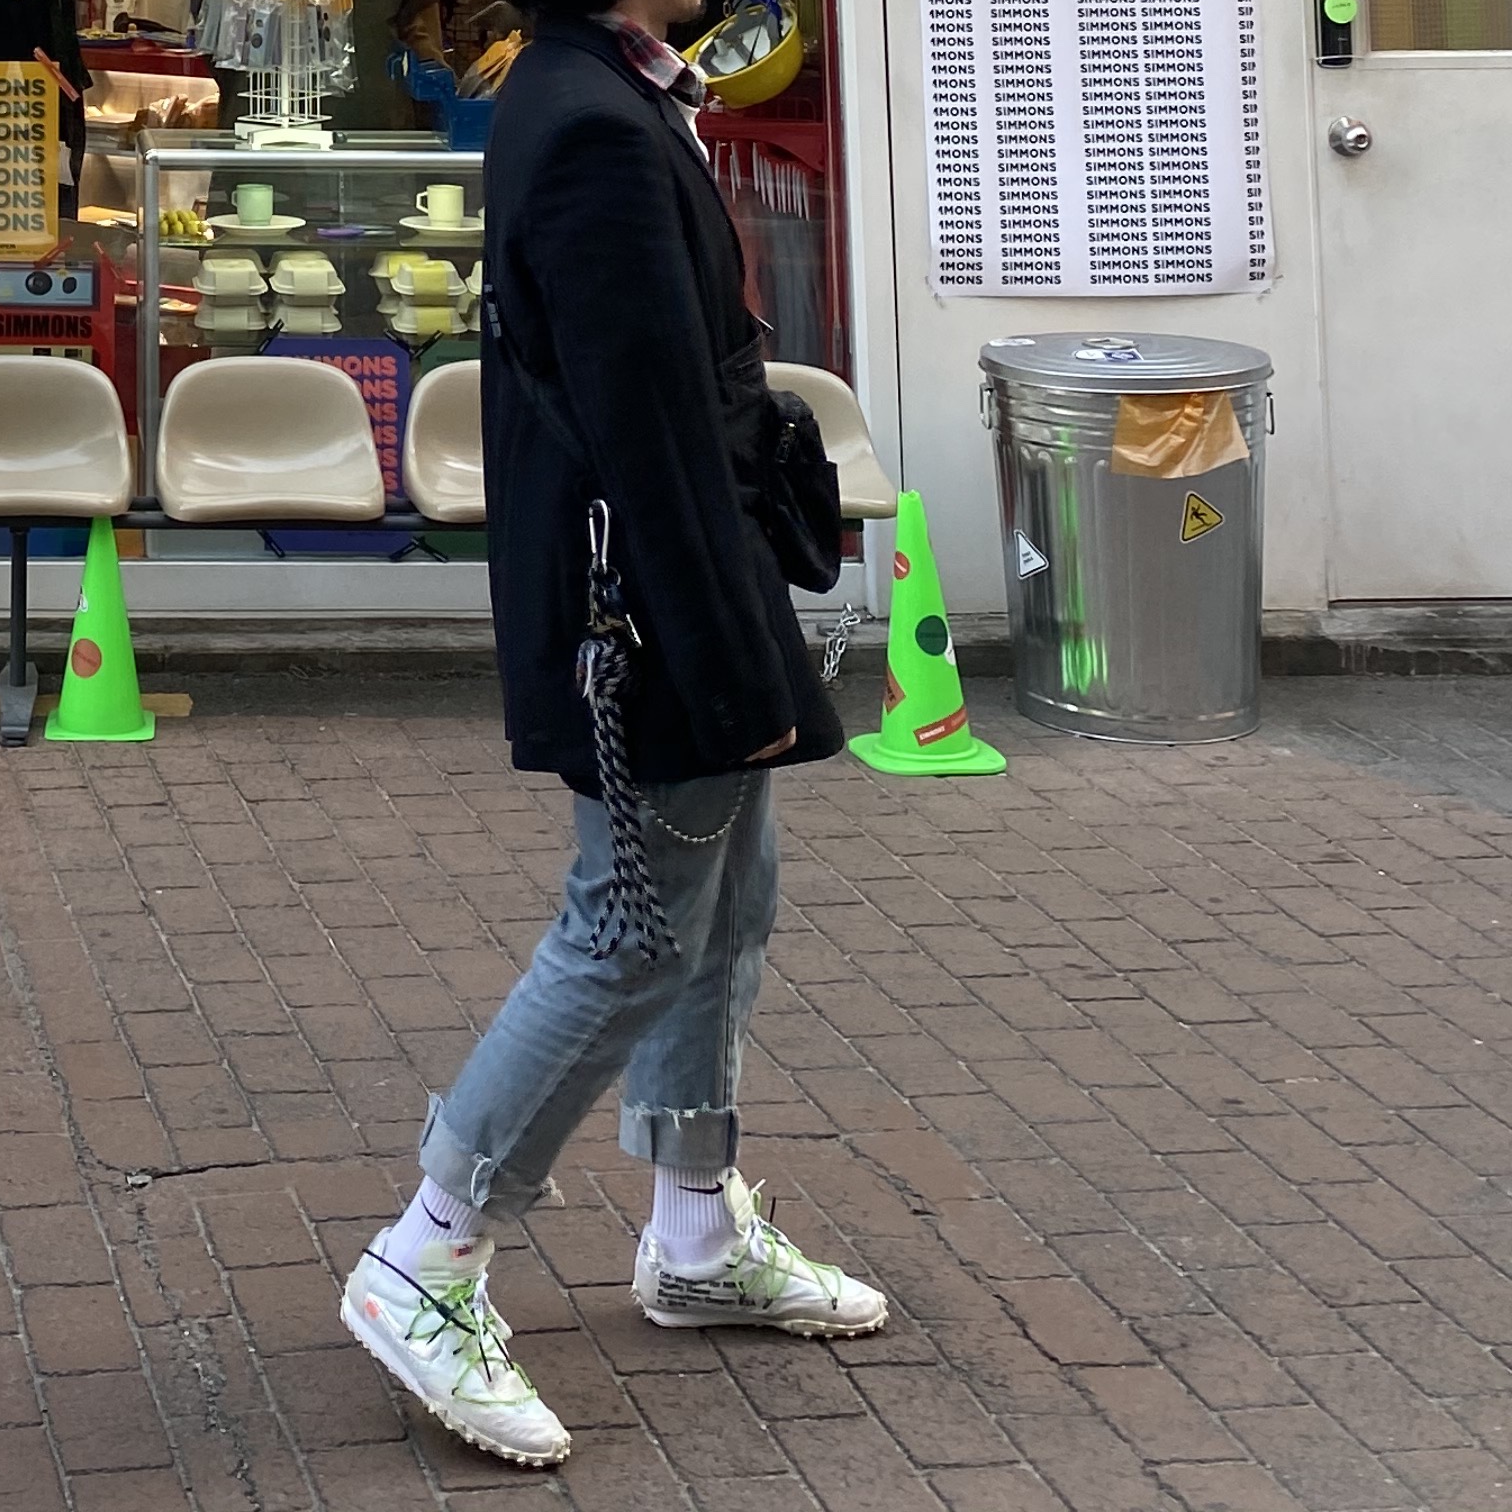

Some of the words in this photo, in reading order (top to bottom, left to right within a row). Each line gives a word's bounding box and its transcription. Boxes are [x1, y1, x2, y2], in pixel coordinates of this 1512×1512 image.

[991, 9, 1049, 18] SIMMONS
[1078, 8, 1136, 17] SIMMONS
[1141, 7, 1201, 17] SIMMONS
[991, 23, 1050, 32] SIMMONS
[1078, 22, 1137, 31] SIMMONS
[1142, 21, 1201, 31] SIMMONS
[992, 36, 1050, 46] SIMMONS
[1079, 35, 1138, 45] SIMMONS
[1143, 35, 1202, 45] SIMMONS
[993, 50, 1051, 60] SIMMONS
[1080, 50, 1138, 59] SIMMONS
[1143, 49, 1203, 58] SIMMONS
[993, 64, 1052, 74] SIMMONS
[1080, 63, 1139, 73] SIMMONS
[1144, 63, 1203, 72] SIMMONS
[995, 92, 1053, 102] SIMMONS
[1082, 91, 1141, 101] SIMMONS
[1145, 91, 1205, 101] SIMMONS
[995, 106, 1054, 116] SIMMONS
[1083, 106, 1141, 115] SIMMONS
[1146, 105, 1206, 114] SIMMONS
[996, 120, 1055, 130] SIMMONS
[1083, 119, 1142, 129] SIMMONS
[1147, 119, 1206, 128] SIMMONS
[997, 134, 1055, 144] SIMMONS
[1084, 133, 1143, 143] SIMMONS
[1148, 133, 1207, 142] SIMMONS
[997, 149, 1056, 158] SIMMONS
[1085, 147, 1143, 157] SIMMONS
[1149, 147, 1208, 157] SIMMONS
[999, 177, 1057, 186] SIMMONS
[1086, 175, 1145, 185] SIMMONS
[1150, 175, 1209, 184] SIMMONS
[999, 191, 1058, 201] SIMMONS
[1087, 190, 1146, 200] SIMMONS
[1151, 189, 1209, 199] SIMMONS
[1000, 205, 1058, 215] SIMMONS
[1087, 204, 1146, 214] SIMMONS
[1151, 203, 1210, 213] SIMMONS
[1000, 219, 1059, 229] SIMMONS
[1088, 218, 1147, 228] SIMMONS
[1152, 217, 1211, 227] SIMMONS
[1001, 233, 1060, 243] SIMMONS
[1089, 232, 1147, 242] SIMMONS
[1153, 231, 1211, 241] SIMMONS
[1002, 261, 1060, 271] SIMMONS
[1090, 260, 1148, 270] SIMMONS
[1154, 259, 1212, 269] SIMMONS
[1002, 275, 1061, 285] SIMMONS
[1090, 274, 1149, 284] SIMMONS
[1154, 273, 1212, 283] SIMMONS
